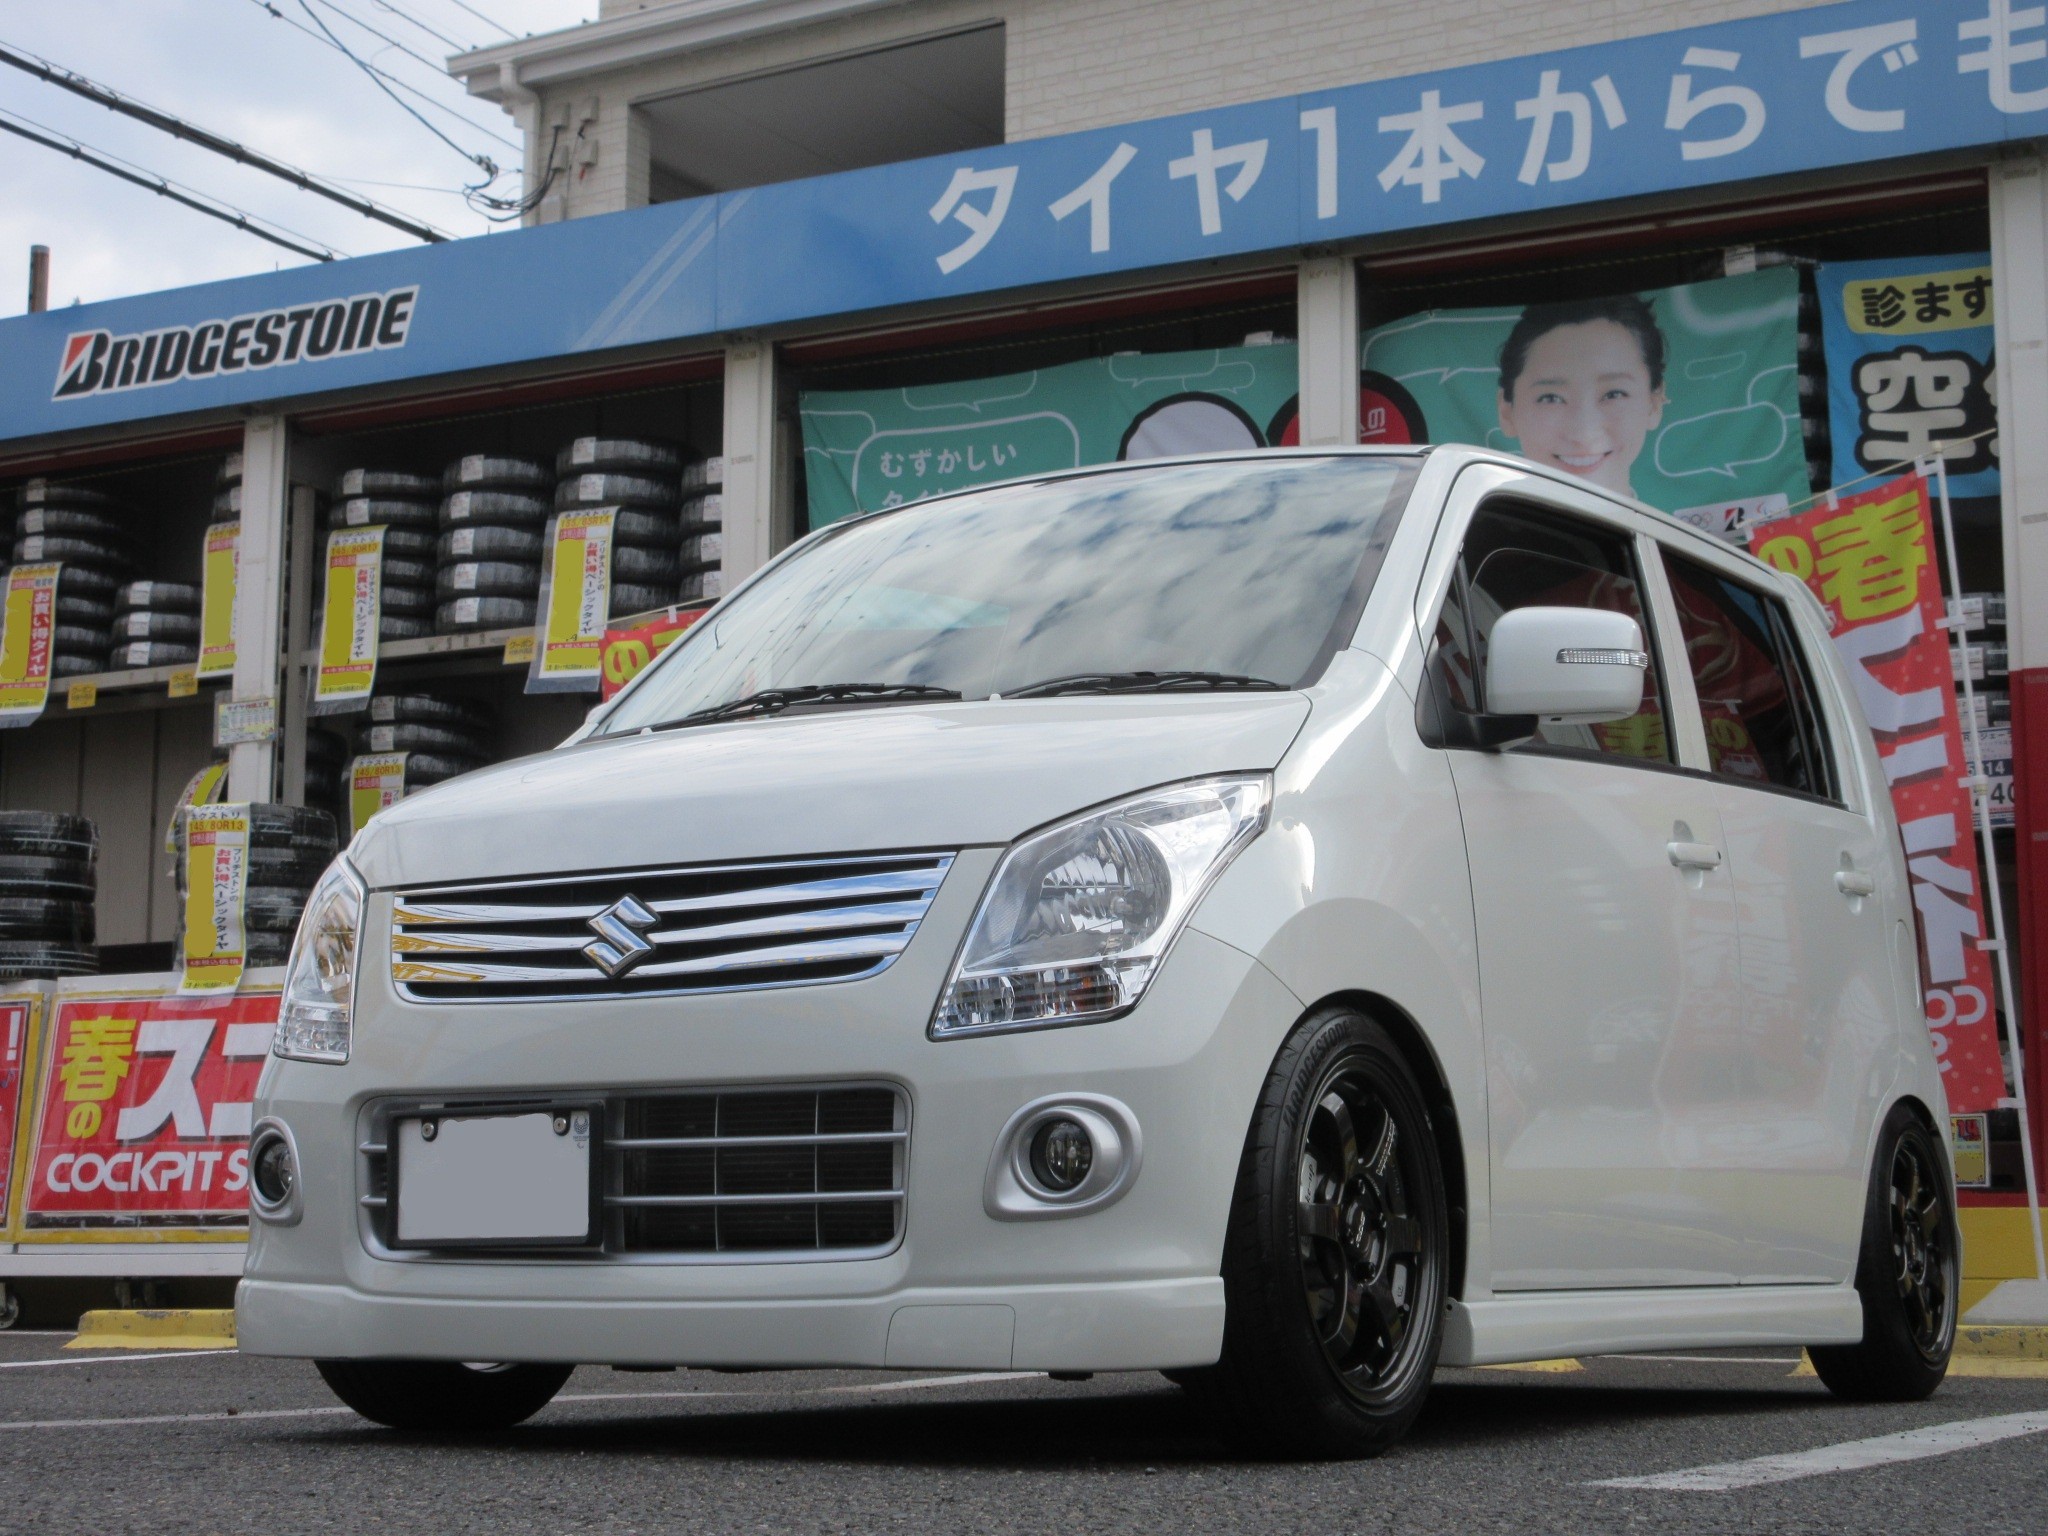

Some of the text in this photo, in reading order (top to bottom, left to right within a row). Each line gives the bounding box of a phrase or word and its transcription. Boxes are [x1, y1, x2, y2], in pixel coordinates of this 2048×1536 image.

[53, 289, 418, 399] BRIDGESTONE
[880, 444, 1017, 478] むずかしい
[1859, 352, 1999, 461] 空
[60, 1015, 137, 1139] 春の
[47, 1151, 222, 1192] COCKPIT
